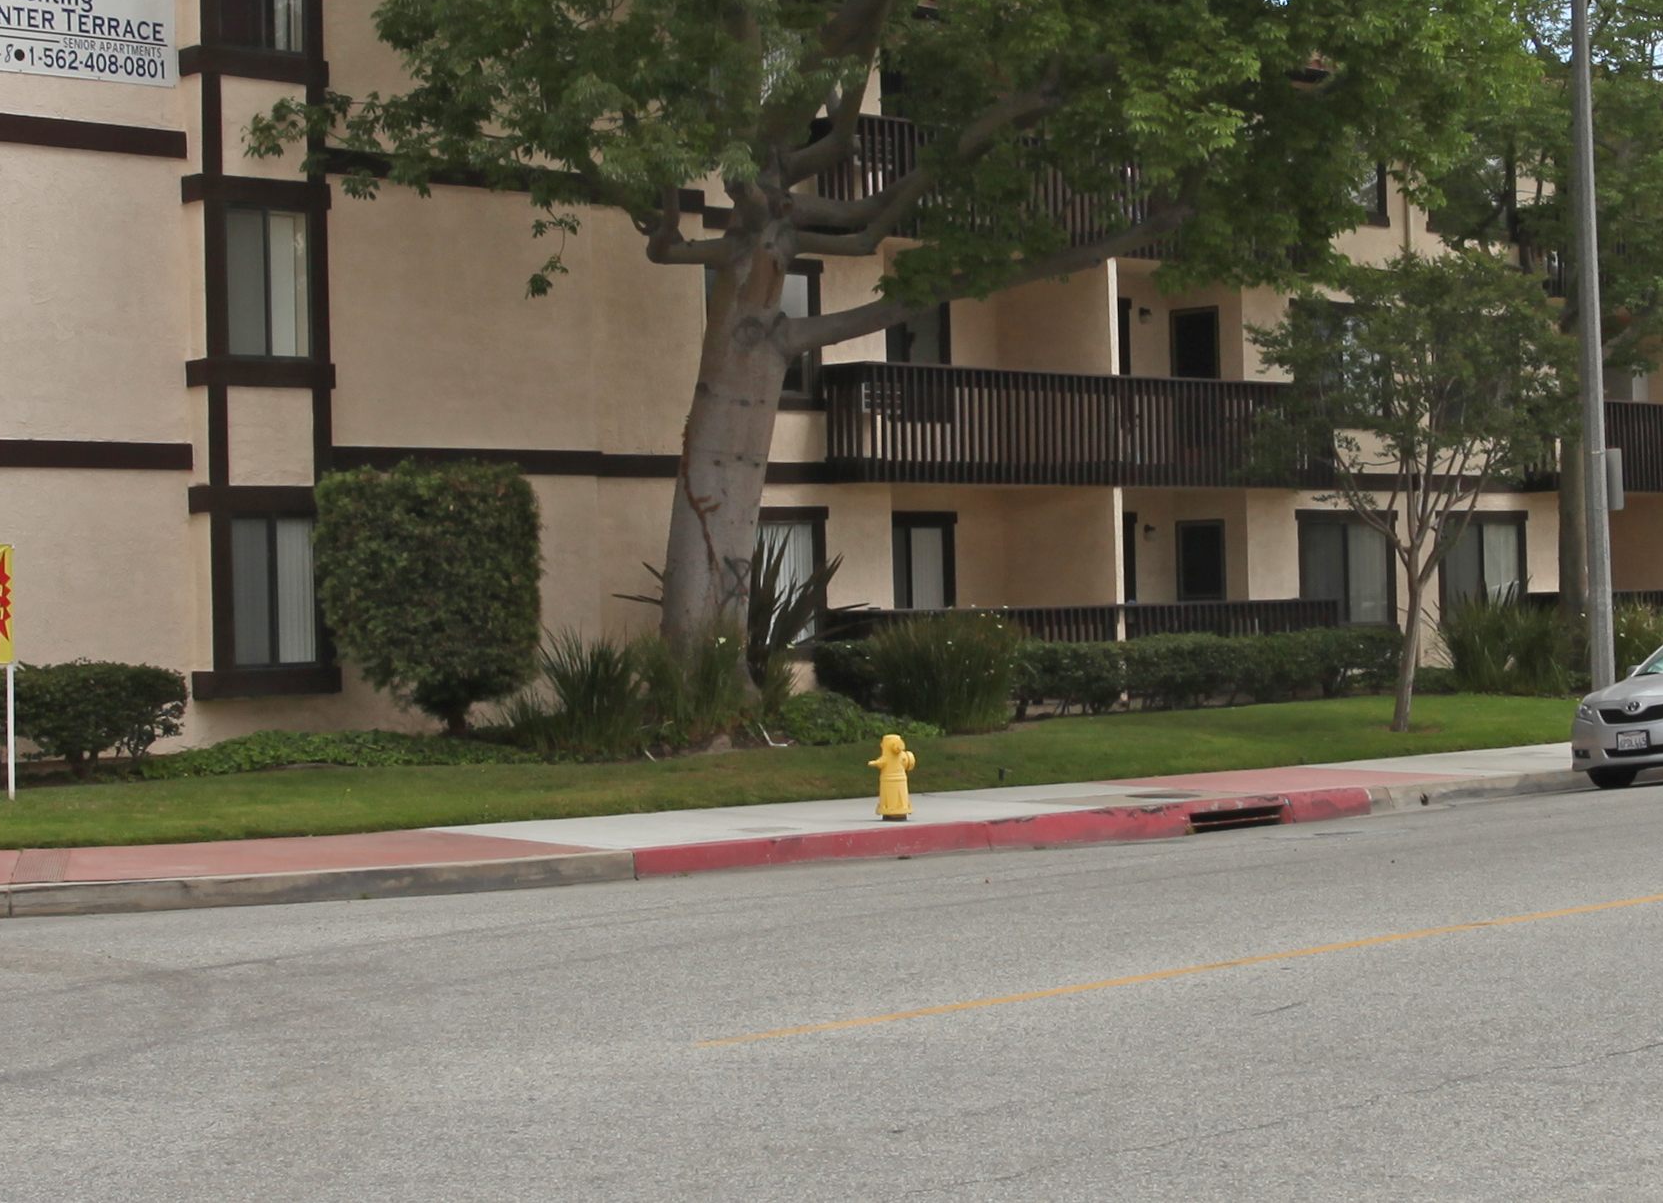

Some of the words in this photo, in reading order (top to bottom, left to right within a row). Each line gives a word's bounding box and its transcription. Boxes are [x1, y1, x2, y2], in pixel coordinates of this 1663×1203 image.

[62, 8, 165, 43] TERRACE
[63, 37, 96, 52] SENIOR
[99, 41, 162, 59] APARTMENTS
